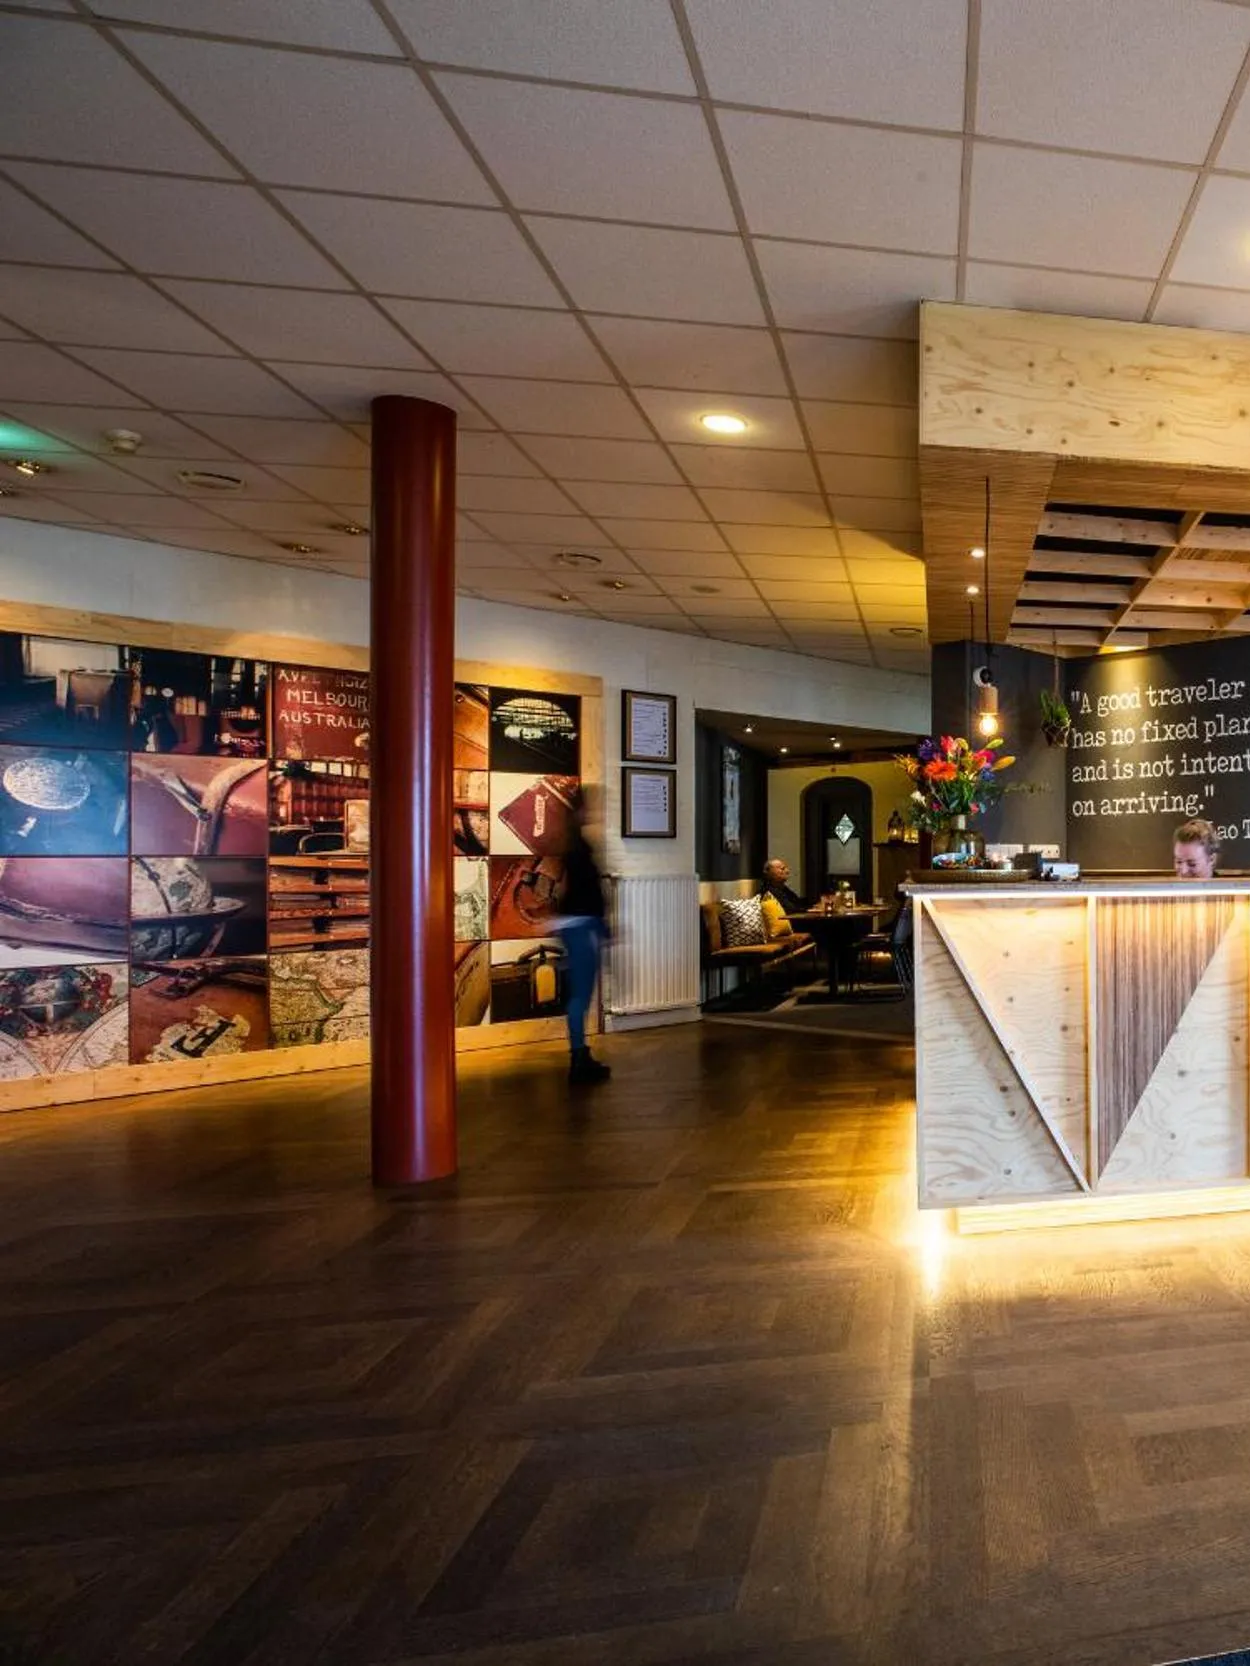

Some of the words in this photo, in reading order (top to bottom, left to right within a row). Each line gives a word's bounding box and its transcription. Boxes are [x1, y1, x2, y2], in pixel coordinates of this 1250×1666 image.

[286, 688, 369, 713] MELBOUR
[1097, 686, 1141, 717] good
[1146, 678, 1246, 707] traveler
[278, 709, 371, 729] AUSTRALIA
[1072, 727, 1106, 749] has
[1111, 726, 1135, 746] no
[1141, 717, 1199, 743] fixed
[1072, 759, 1108, 783] and
[1112, 755, 1134, 780] is
[1139, 754, 1174, 778] not
[1072, 799, 1096, 817] on
[1100, 784, 1215, 817] arriving."
[1207, 820, 1239, 840] ao
